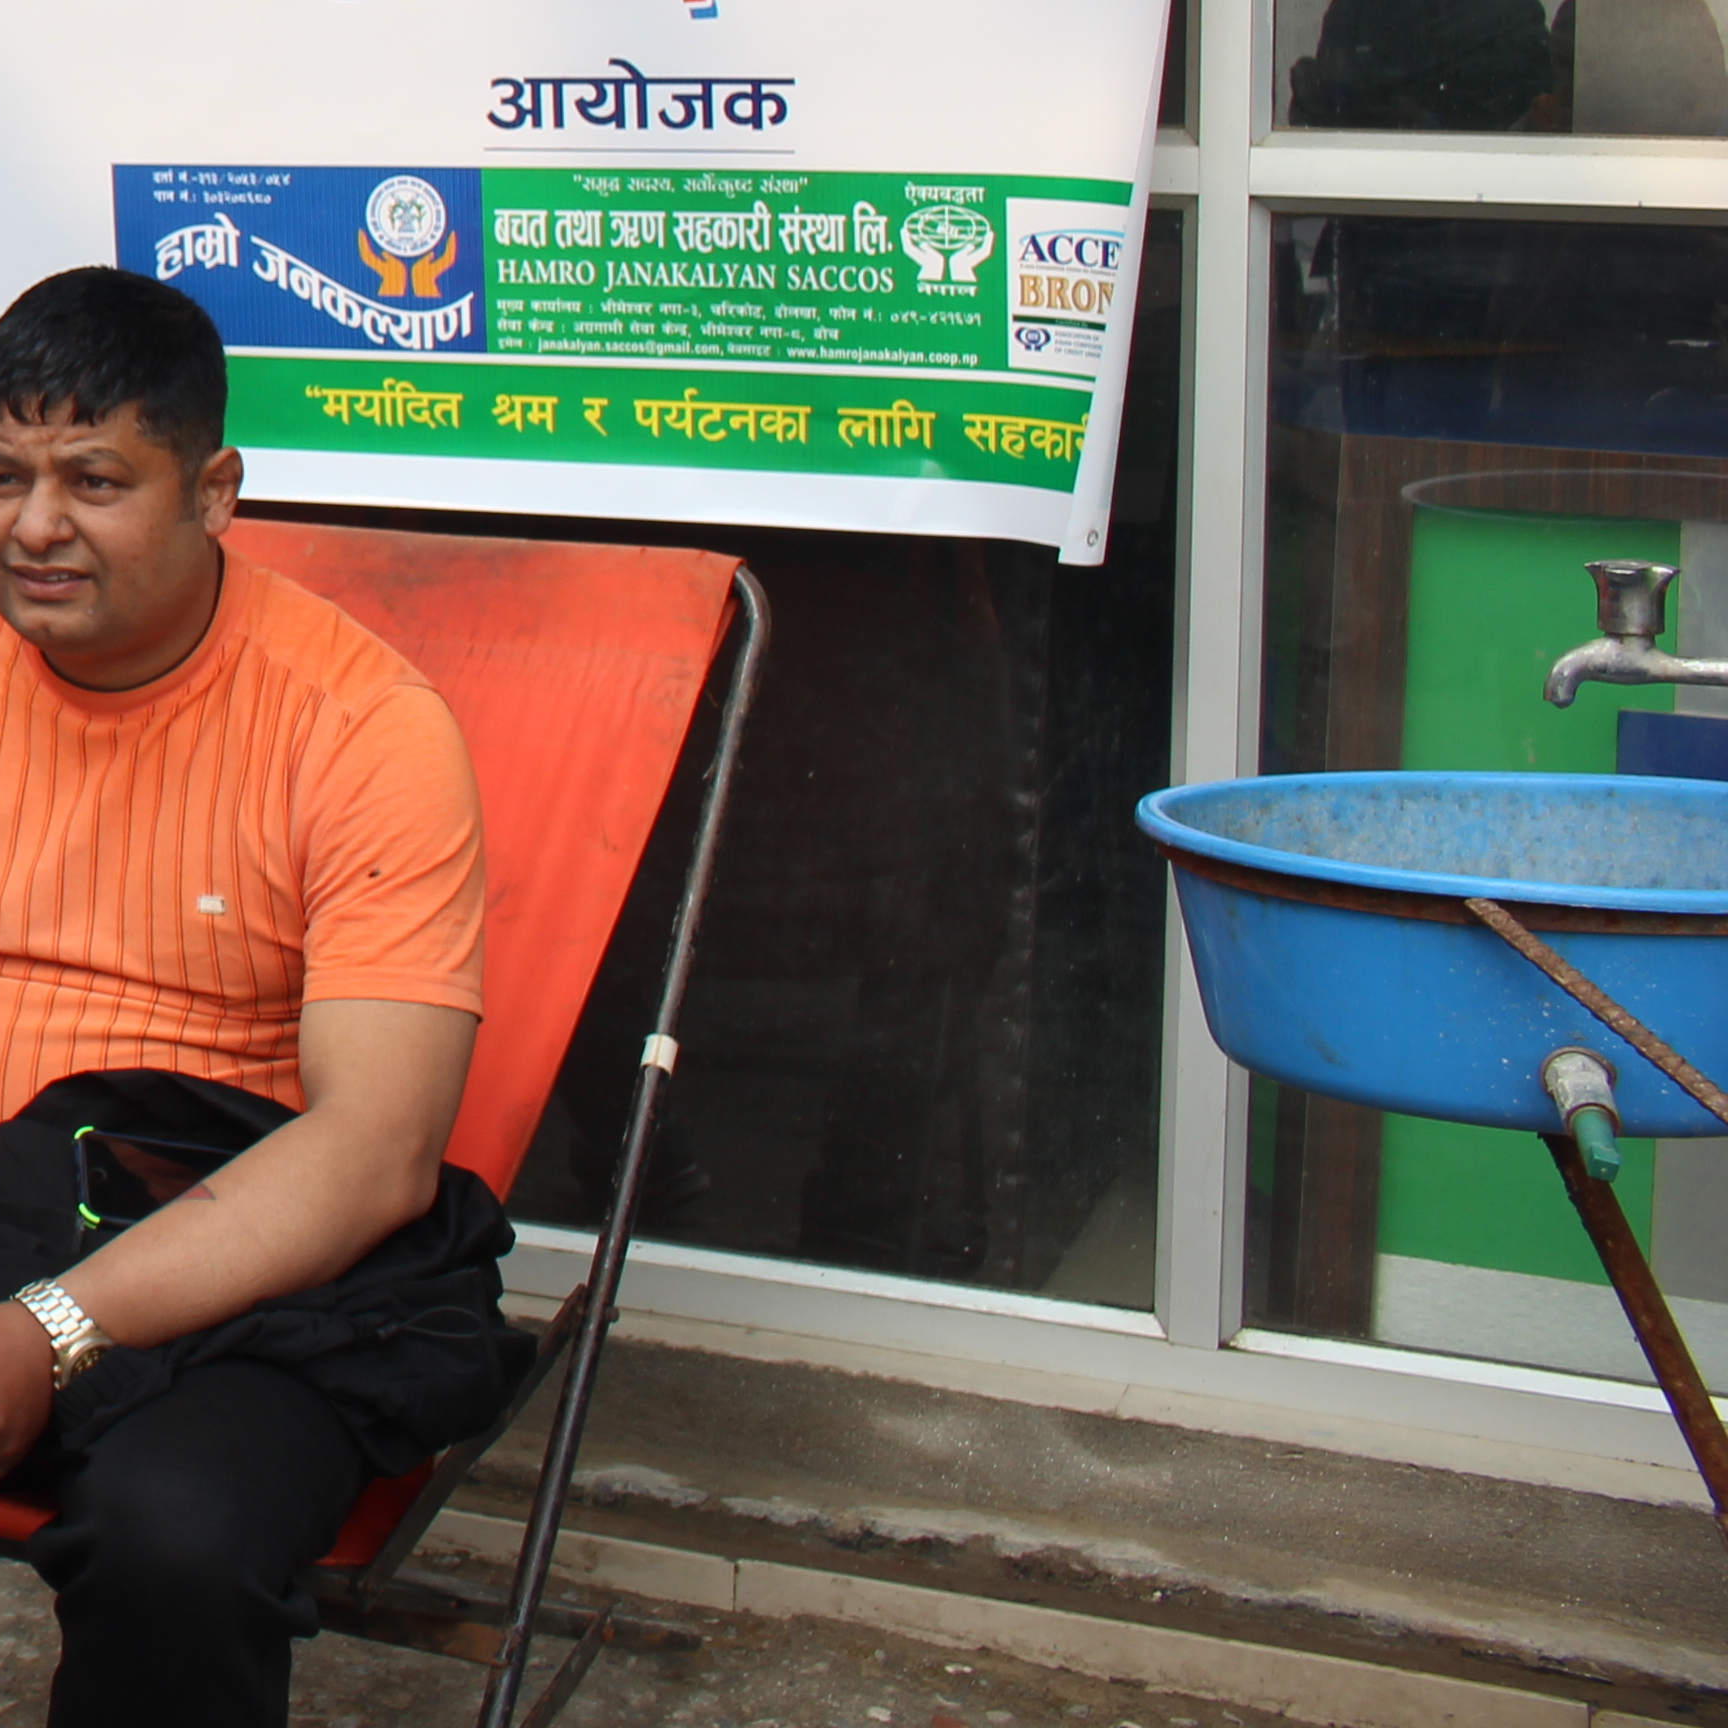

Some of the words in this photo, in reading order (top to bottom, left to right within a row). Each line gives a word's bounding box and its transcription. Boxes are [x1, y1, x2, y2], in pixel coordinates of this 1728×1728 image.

[486, 59, 796, 132] आयोजक
[494, 208, 547, 248] बचत
[554, 209, 602, 248] तथा
[610, 210, 665, 248] ऋण
[673, 200, 771, 253] सहकारी
[778, 204, 846, 255] संस्था
[852, 200, 893, 255] लि.
[154, 212, 241, 281] हाम्रो
[250, 234, 474, 350] जनकल्याण
[497, 258, 596, 286] HAMRO
[603, 260, 776, 293] JANAKALYAN
[787, 264, 894, 294] SACCOS
[917, 282, 978, 297] नेपाल
[787, 344, 978, 367] www.hamrojanakalyan.coop.np
[492, 392, 558, 432] श्रम
[582, 397, 609, 437] र
[634, 388, 811, 444] पर्यटनका
[837, 399, 935, 448] लागि
